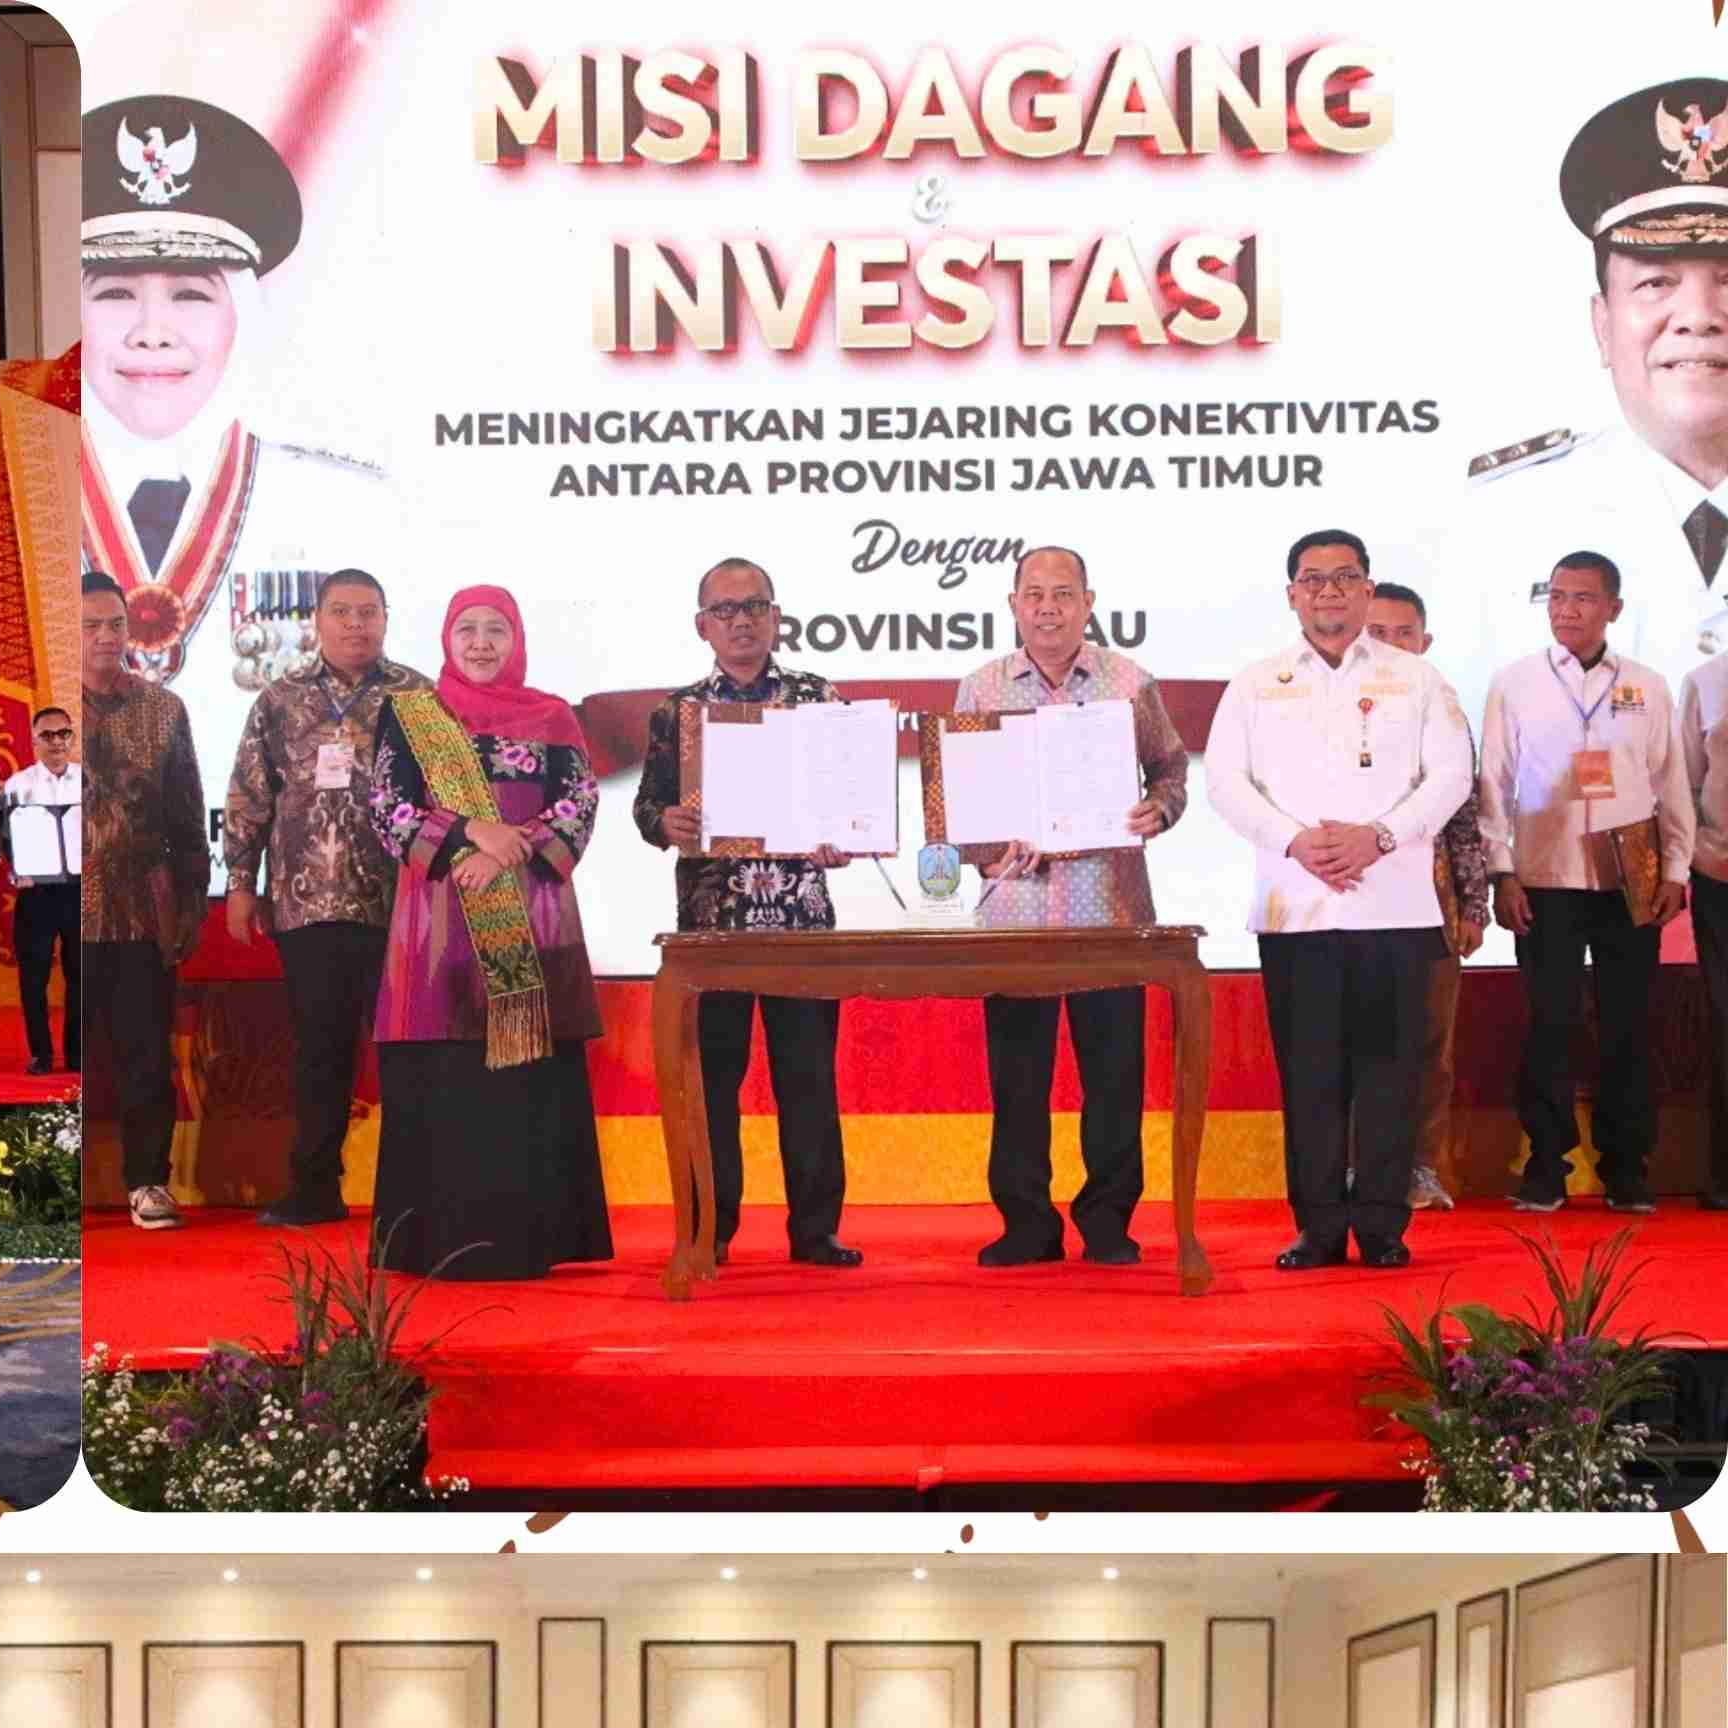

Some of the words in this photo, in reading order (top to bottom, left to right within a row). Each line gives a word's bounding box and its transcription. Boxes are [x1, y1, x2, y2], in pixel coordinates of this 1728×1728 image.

[472, 46, 759, 166] MISI
[795, 38, 1396, 163] DAGANG
[910, 174, 951, 223] &
[591, 232, 1284, 353] INVESTASI
[435, 408, 824, 447] MENINGKATKAN
[839, 404, 1072, 441] JEJARING
[1088, 399, 1440, 437] KONEKTIVITAS
[549, 461, 752, 498] ANTARA
[767, 458, 996, 495] PROVINSI
[1010, 456, 1156, 492] JAWA
[1167, 454, 1323, 490] TIMUR
[852, 519, 1024, 590] Dengan
[772, 612, 995, 652] ROVINSI
